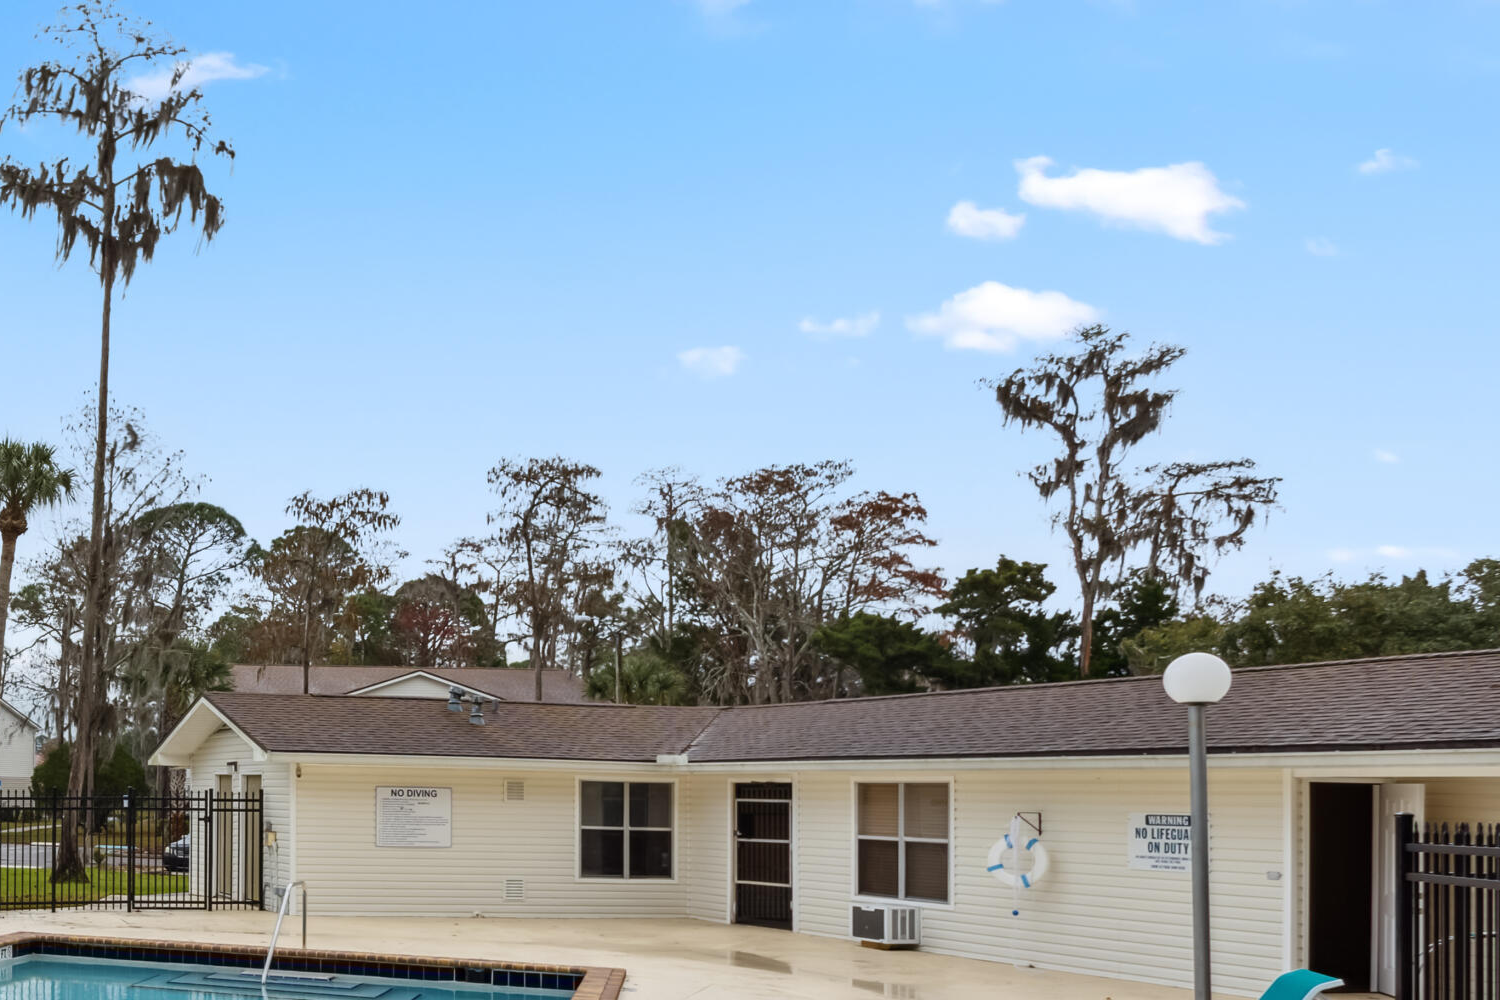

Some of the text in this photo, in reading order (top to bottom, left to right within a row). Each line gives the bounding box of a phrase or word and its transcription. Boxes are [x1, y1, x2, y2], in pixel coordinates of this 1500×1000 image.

[390, 789, 438, 798] NO DIVING
[1148, 815, 1189, 825] WARNING
[1135, 827, 1192, 841] NO LIFEGUA
[1148, 842, 1189, 855] ON DUTY
